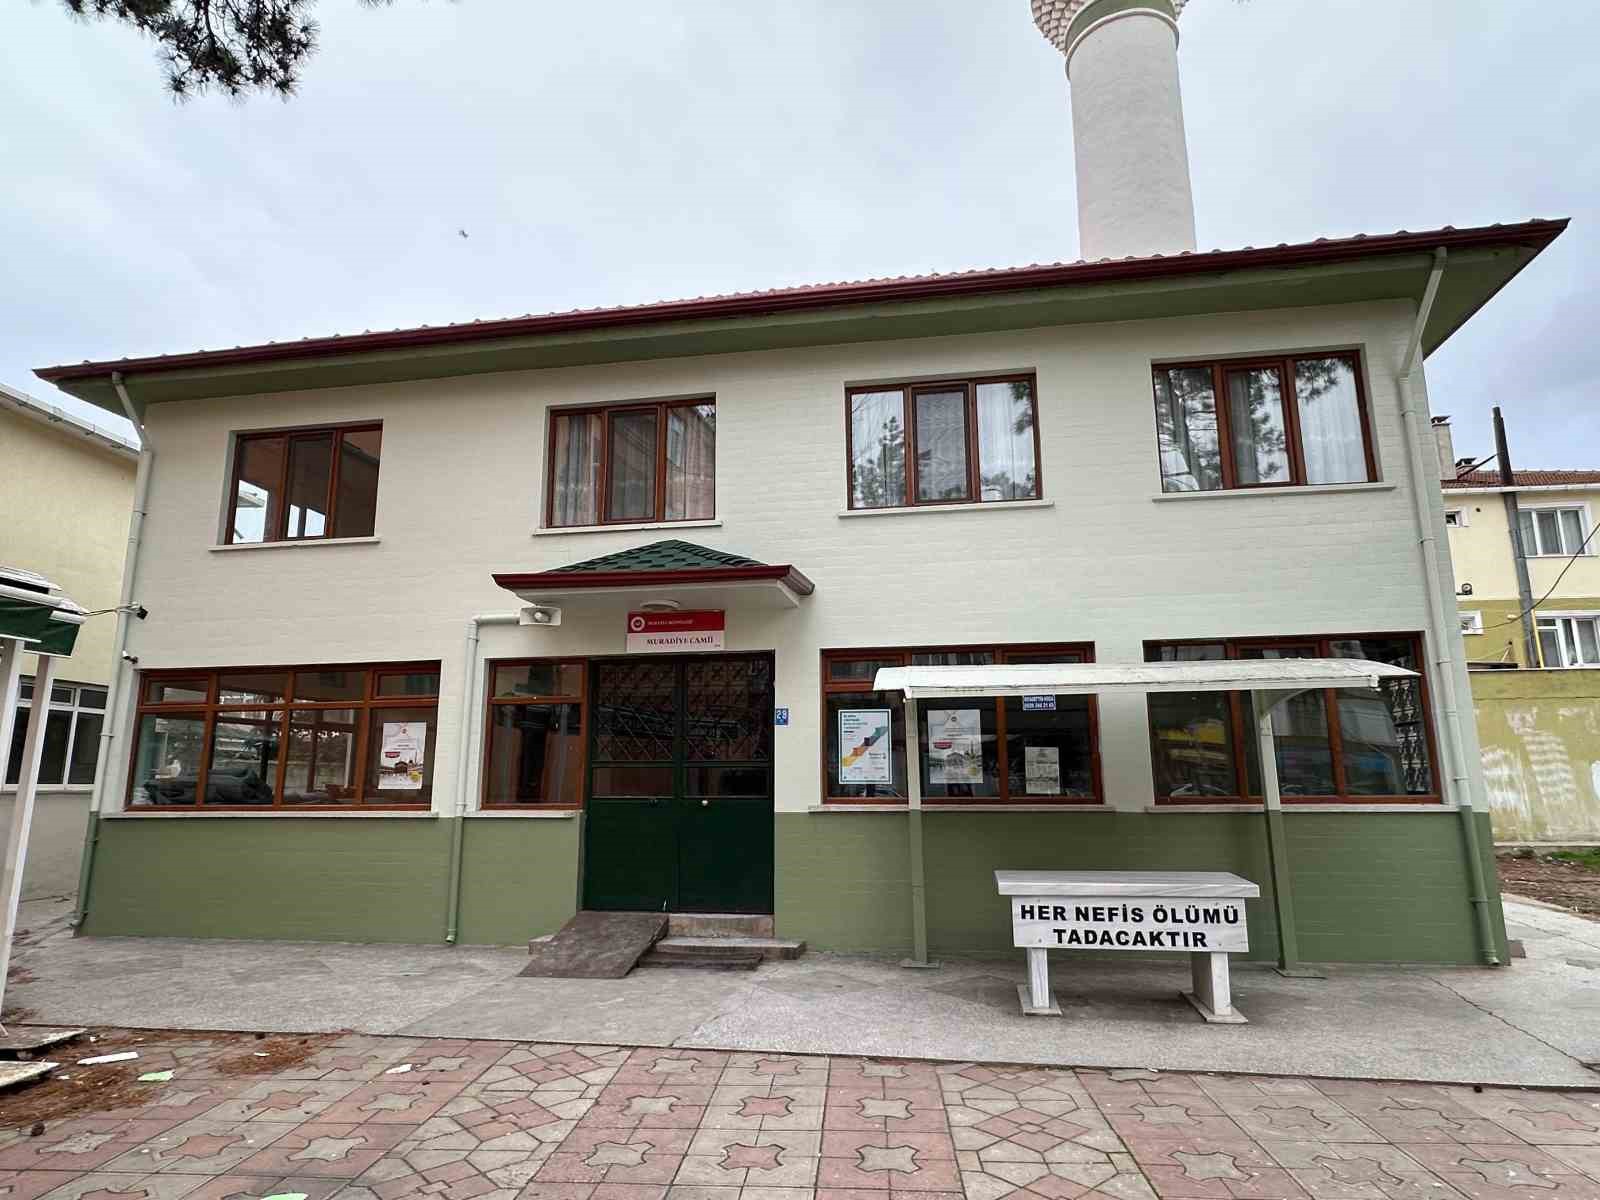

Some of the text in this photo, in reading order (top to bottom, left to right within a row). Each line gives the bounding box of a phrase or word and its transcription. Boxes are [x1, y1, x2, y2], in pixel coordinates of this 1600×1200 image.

[1021, 904, 1239, 924] HER NEFİS ÖLÜMÜ
[1053, 929, 1208, 948] TADACAKTIR
